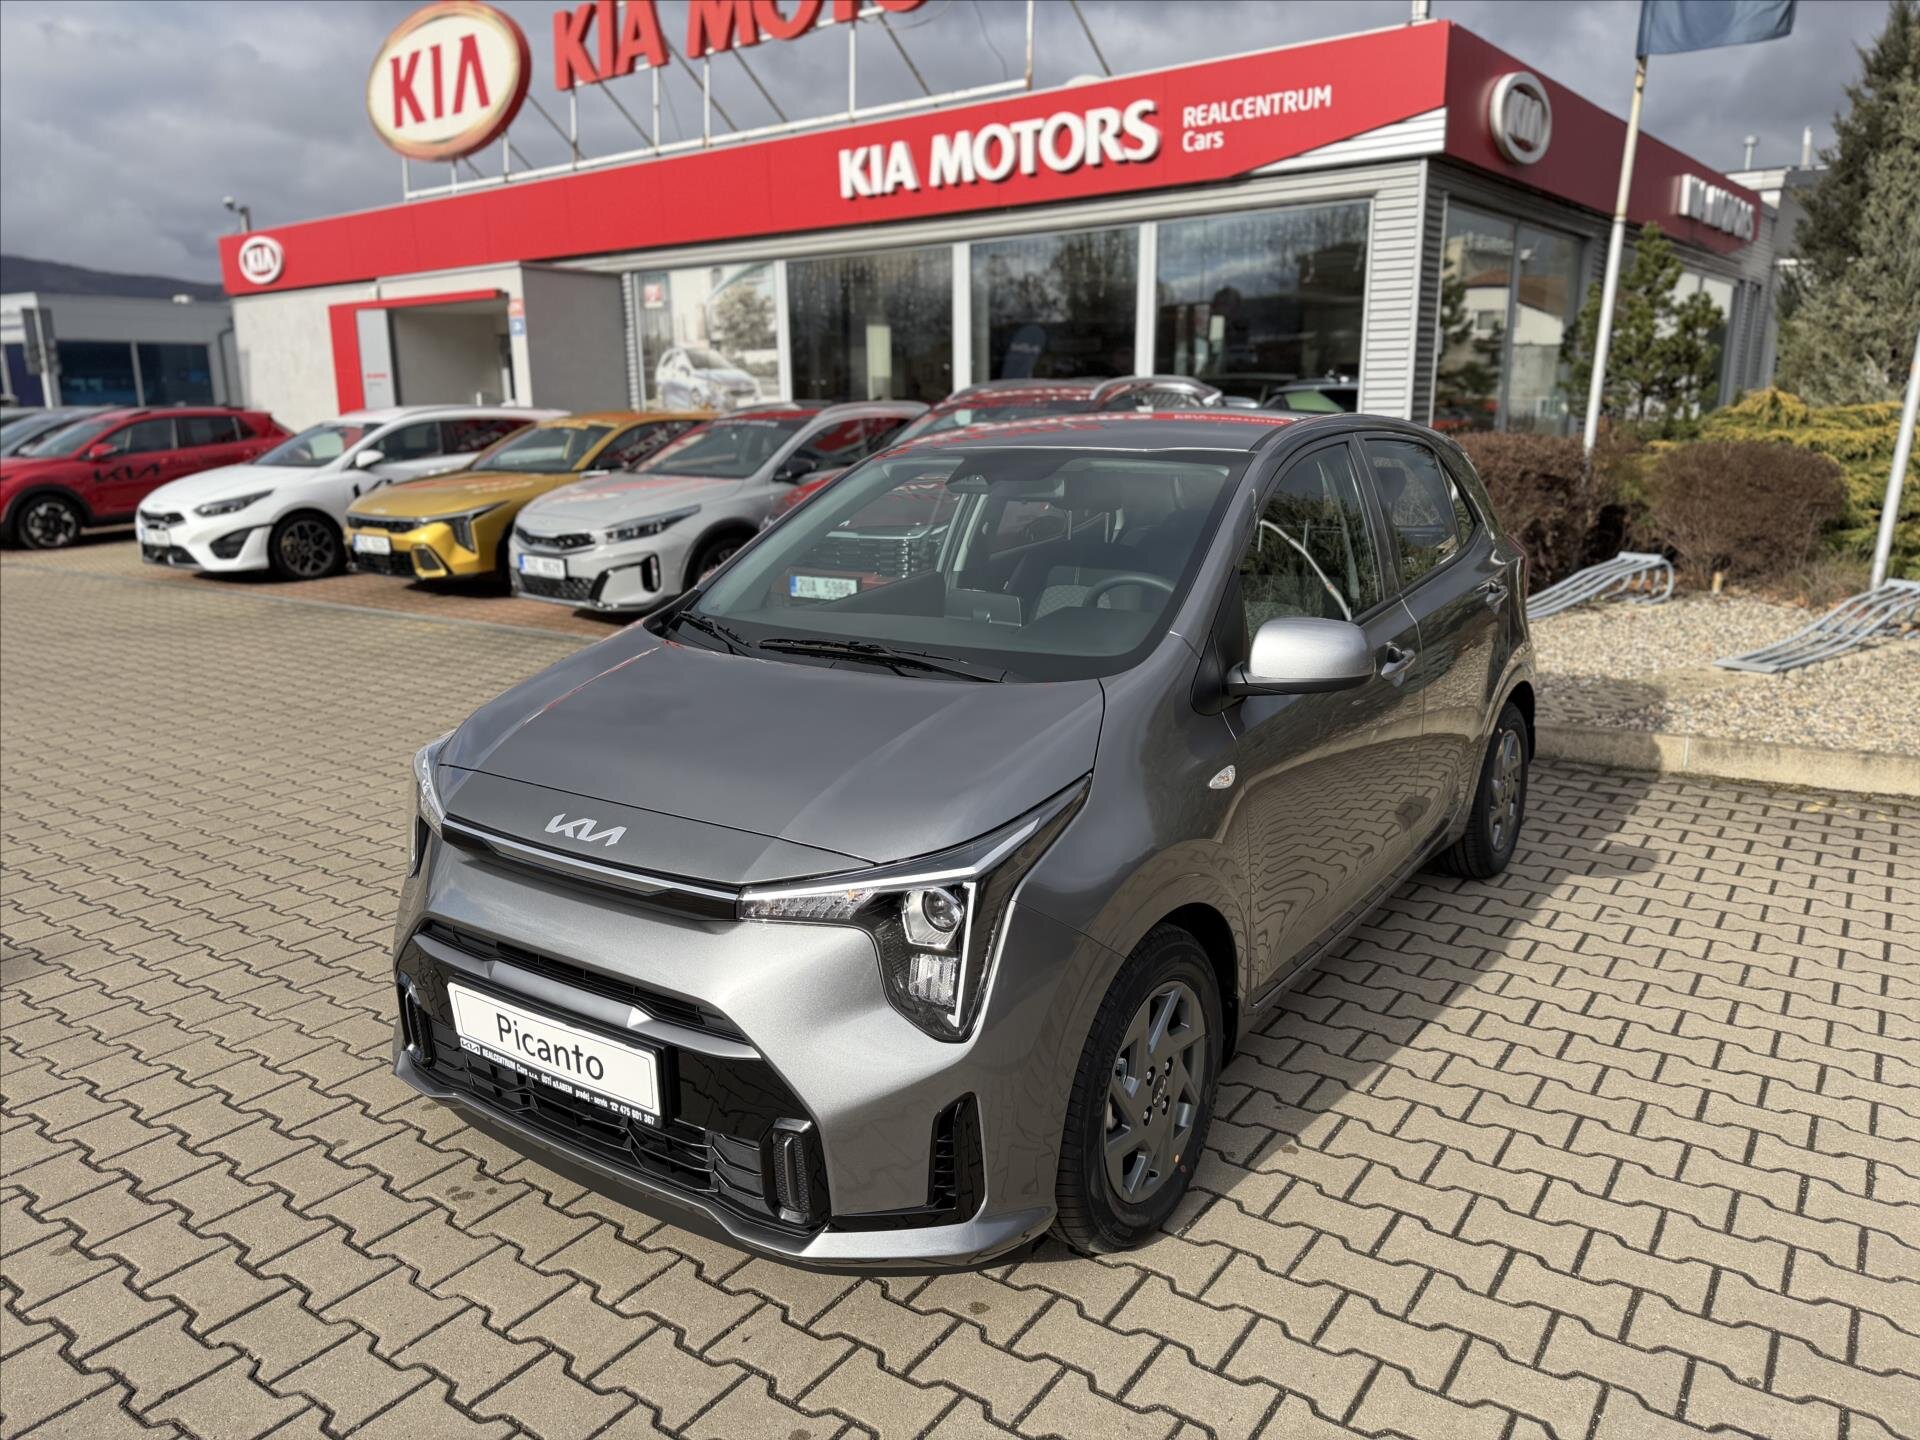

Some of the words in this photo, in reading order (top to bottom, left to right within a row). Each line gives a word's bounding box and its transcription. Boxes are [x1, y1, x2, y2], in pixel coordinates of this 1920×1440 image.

[553, 0, 670, 92] KIA
[390, 33, 490, 129] KIA
[1182, 84, 1332, 129] REALCENTRUM
[838, 140, 920, 199] KIA
[929, 98, 1161, 188] MOTORS
[1182, 130, 1225, 153] Cars
[496, 1013, 604, 1080] Picanto
[482, 1048, 516, 1071] REALCENTRUM
[620, 1104, 631, 1117] 475
